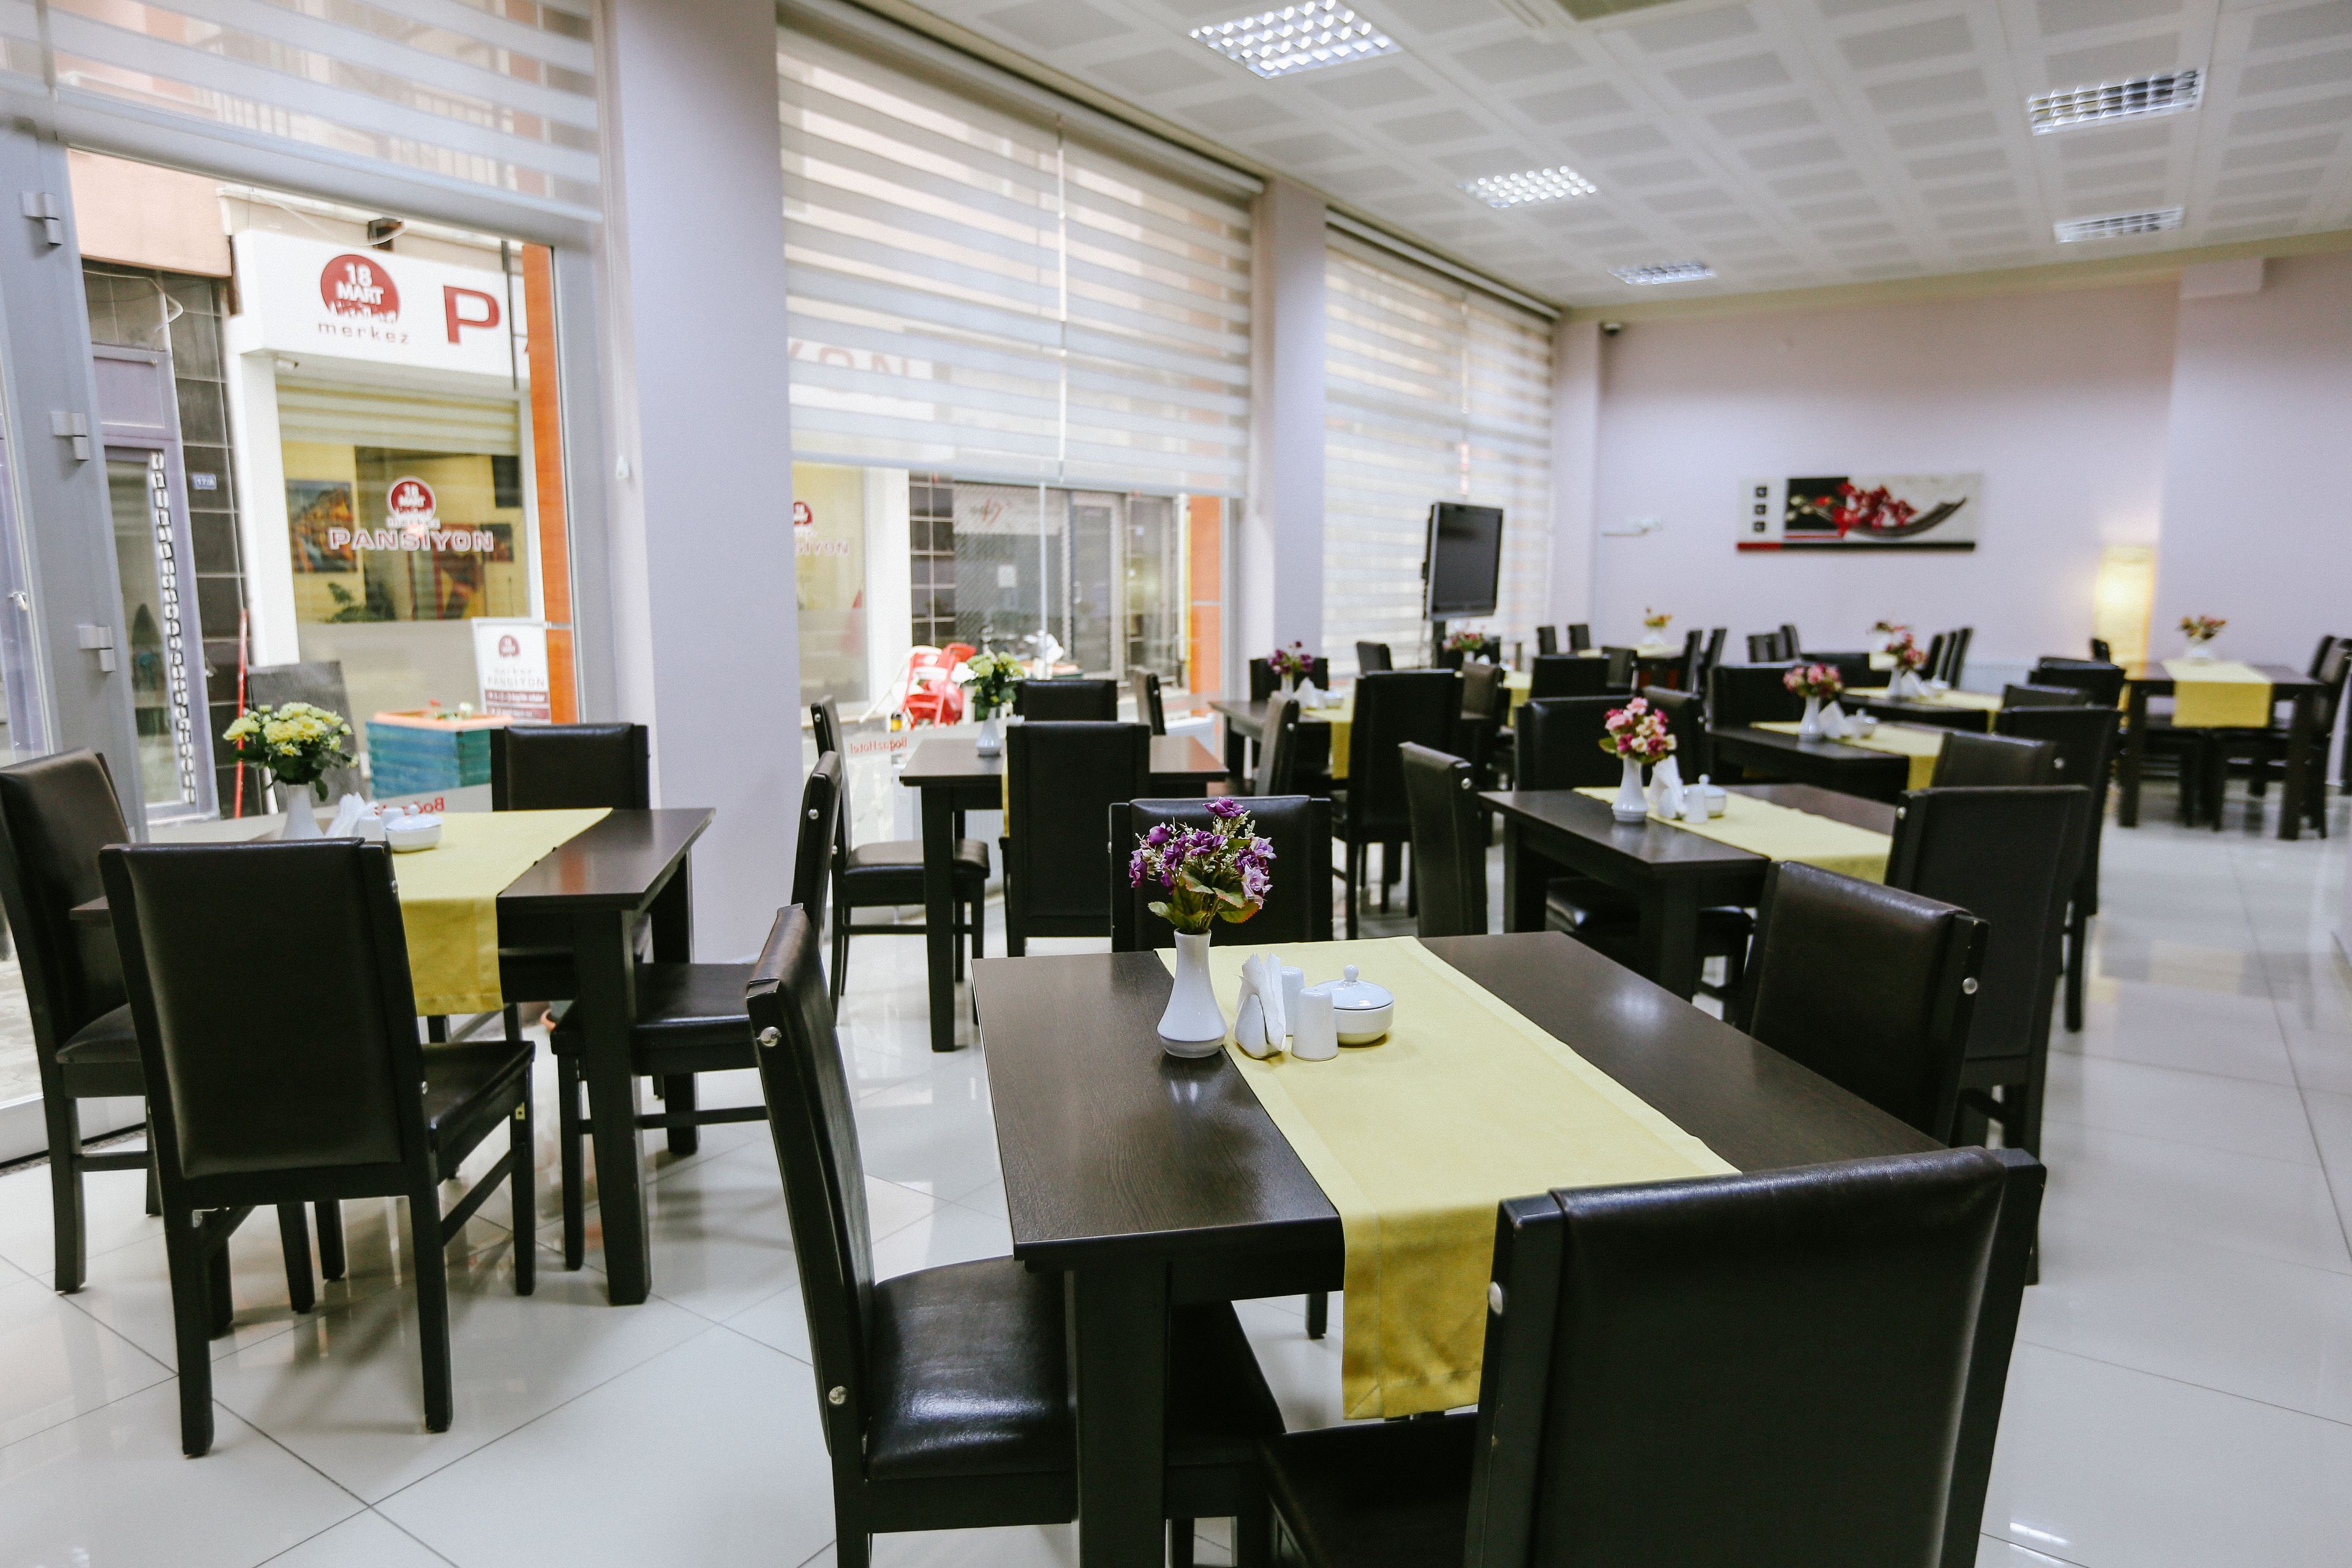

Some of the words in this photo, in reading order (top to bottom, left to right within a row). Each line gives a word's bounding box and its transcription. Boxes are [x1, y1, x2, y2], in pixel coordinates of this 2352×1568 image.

[345, 263, 372, 285] 18
[336, 280, 385, 305] MART
[328, 527, 494, 551] PANSIYON
